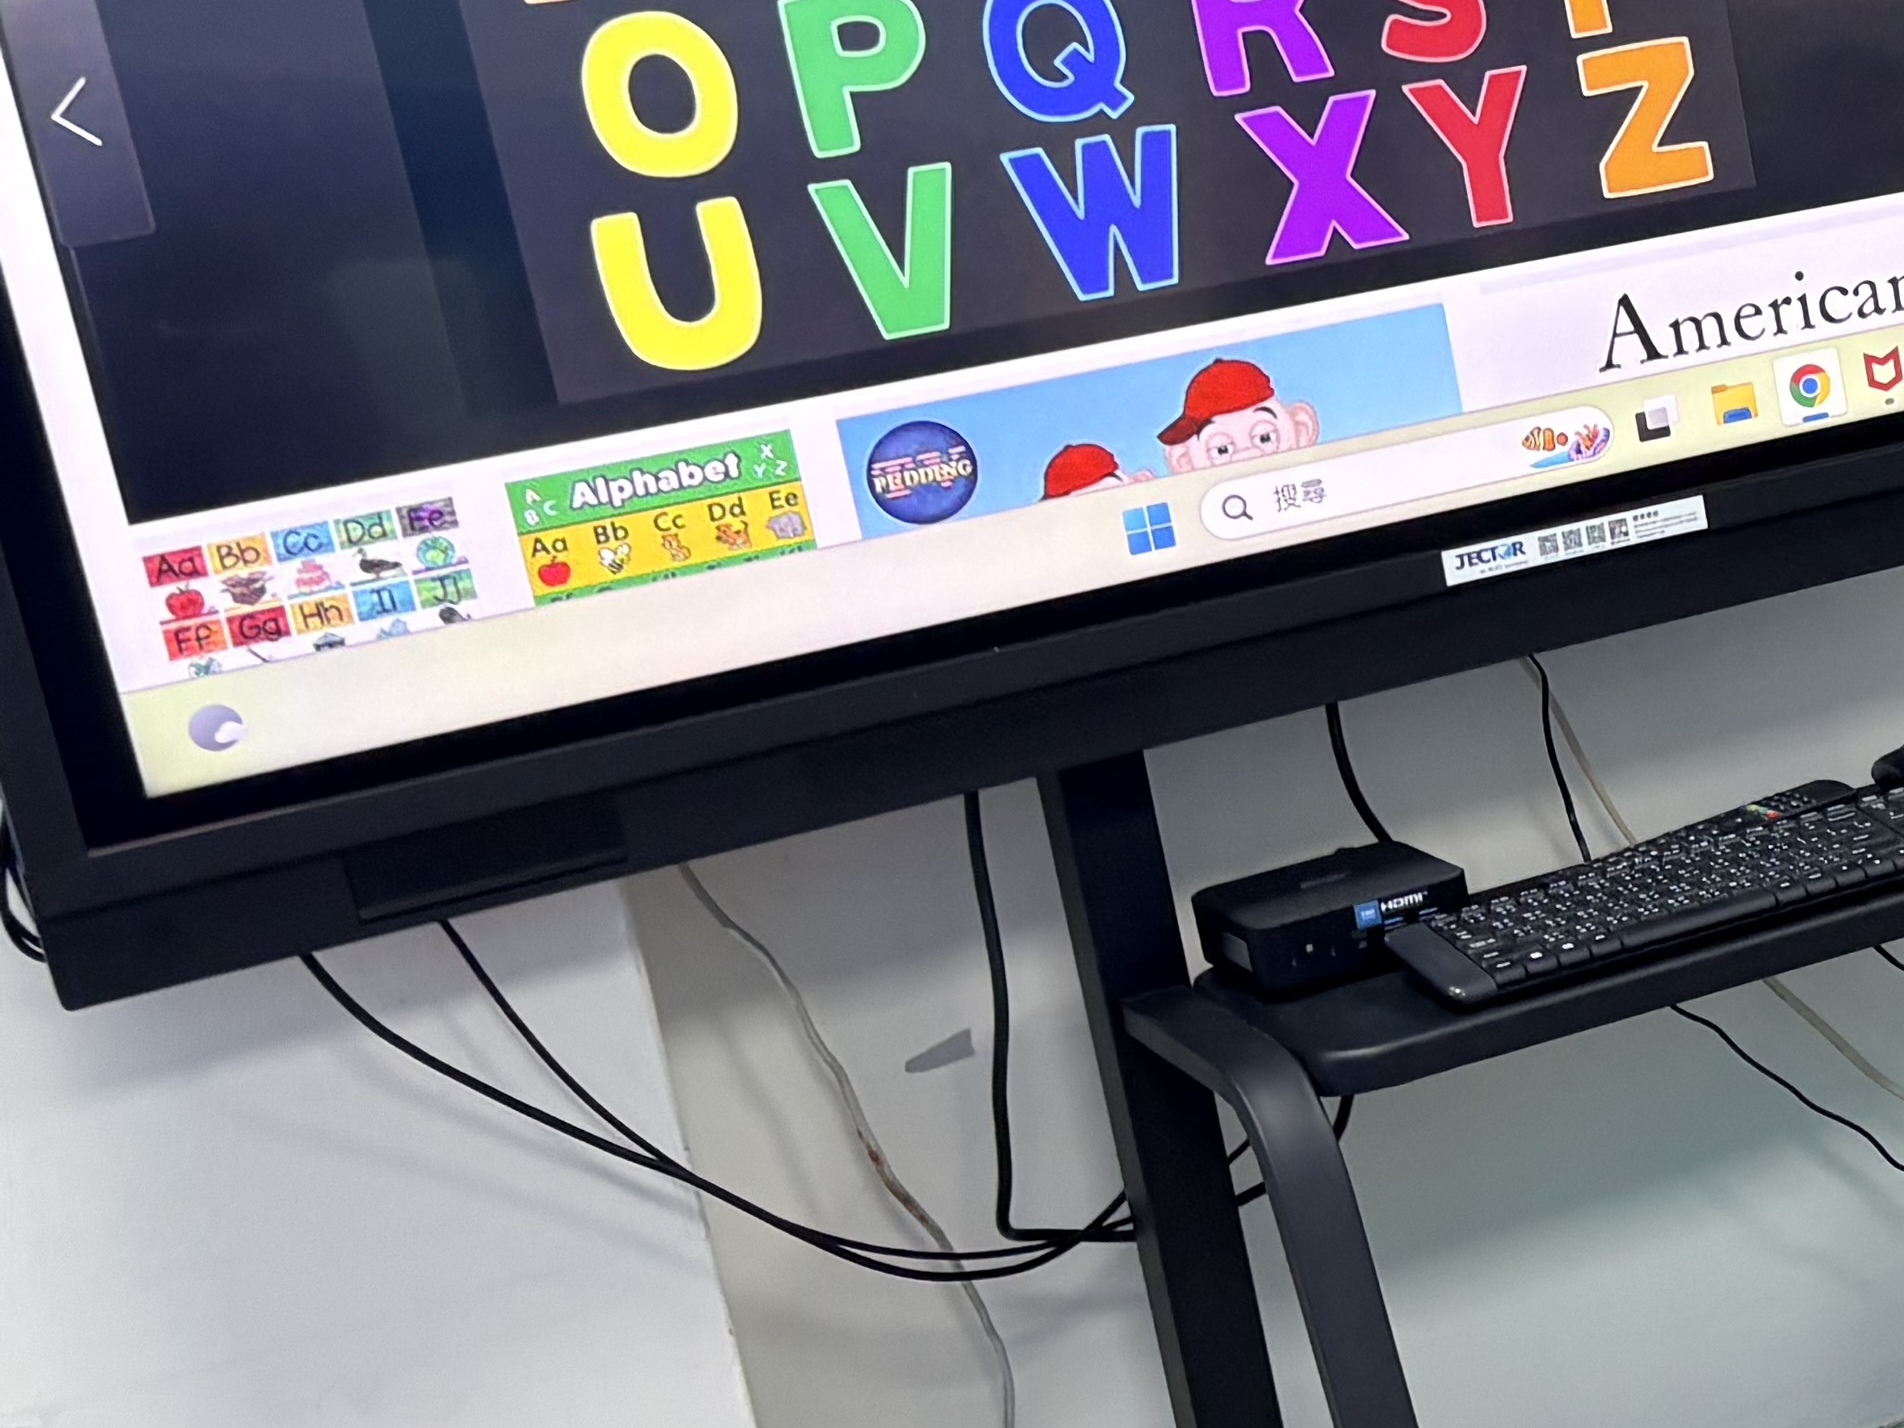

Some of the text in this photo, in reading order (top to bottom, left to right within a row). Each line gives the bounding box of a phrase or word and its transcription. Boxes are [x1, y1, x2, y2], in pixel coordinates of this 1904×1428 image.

[581, 10, 739, 179] O
[591, 37, 1713, 371] U V W X Y Z
[570, 451, 741, 509] Alphabet
[1273, 478, 1327, 512] 搜尋
[157, 554, 198, 582] Aa
[216, 541, 261, 570] Bb
[283, 530, 324, 556] Cc
[343, 518, 388, 544] Dd
[532, 489, 799, 558] Aa Bb Cc Dd Ee
[238, 614, 283, 642] Gg
[300, 603, 342, 629] Hh
